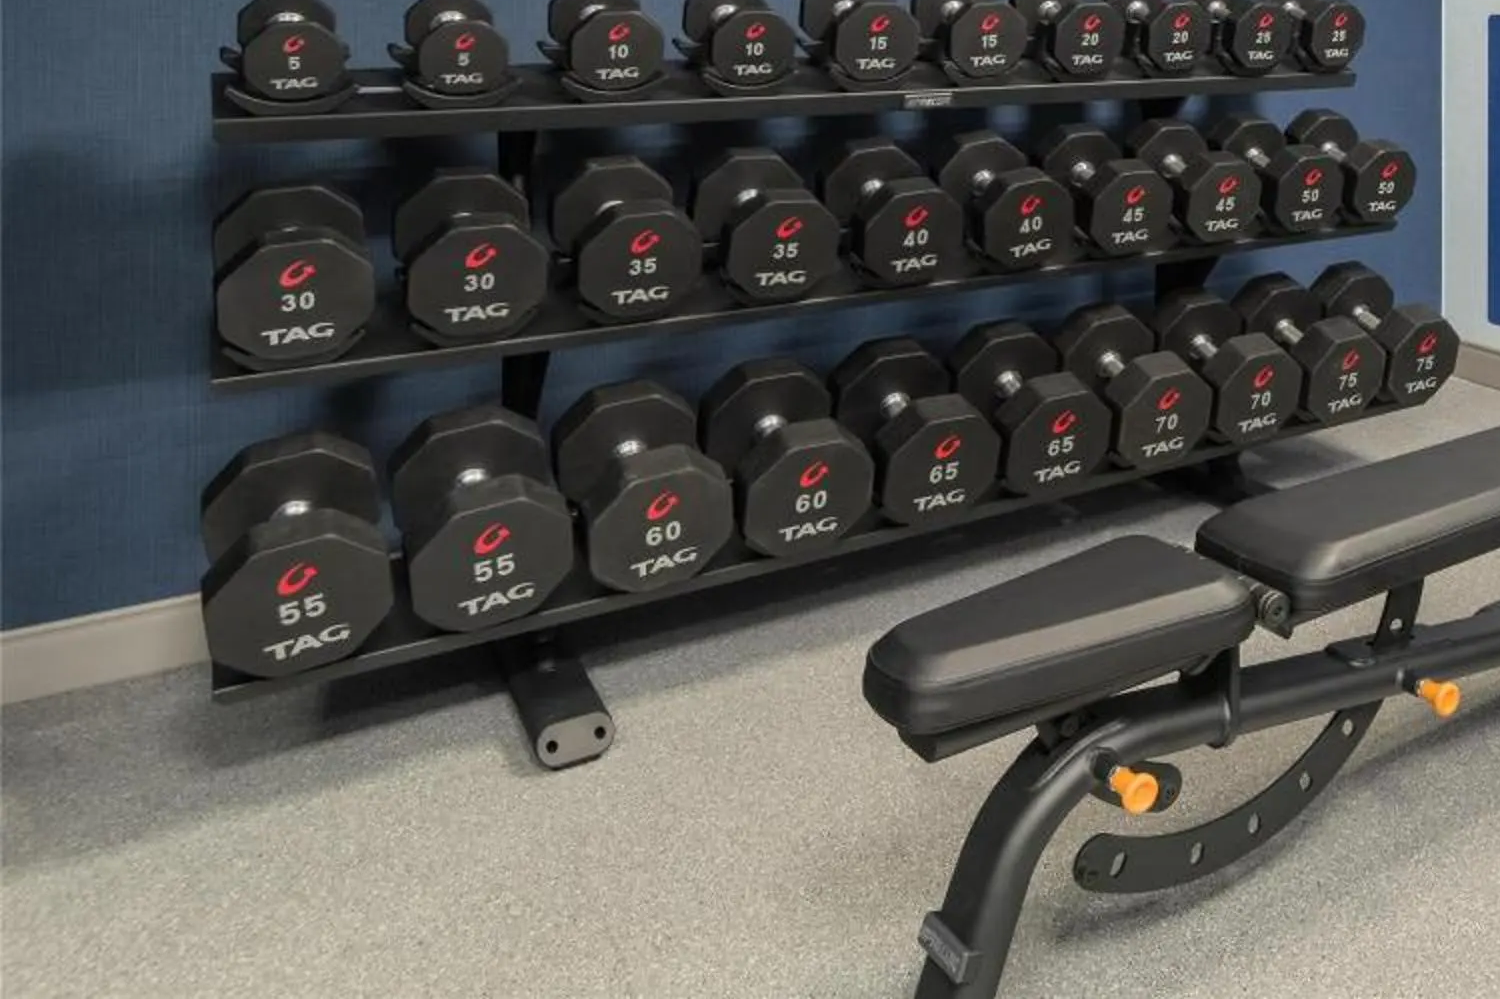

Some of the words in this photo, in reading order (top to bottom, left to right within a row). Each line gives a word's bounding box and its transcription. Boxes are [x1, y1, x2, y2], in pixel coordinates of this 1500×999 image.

[869, 36, 888, 51] 15
[981, 34, 998, 49] 15
[1081, 32, 1099, 46] 20
[1171, 30, 1189, 44] 20
[608, 44, 629, 60] 10
[745, 42, 765, 56] 10
[1163, 50, 1193, 63] TAG
[1247, 50, 1274, 61] TAG
[1324, 48, 1349, 58] TAG
[288, 56, 301, 71] 5
[457, 52, 470, 67] 5
[855, 57, 896, 70] TAG
[969, 54, 1006, 68] TAG
[1071, 54, 1104, 66] TAG
[595, 66, 640, 80] TAG
[733, 62, 773, 76] TAG
[270, 76, 319, 90] TAG
[441, 72, 483, 85] TAG
[1301, 188, 1320, 204] 50
[1377, 181, 1395, 195] 50
[1215, 196, 1236, 212] 45
[1368, 200, 1396, 212] TAG
[1122, 207, 1145, 223] 45
[1291, 208, 1323, 222] TAG
[1019, 215, 1043, 234] 40
[1205, 218, 1239, 232] TAG
[902, 228, 929, 248] 40
[1111, 228, 1149, 245] TAG
[772, 242, 799, 260] 35
[1009, 238, 1052, 258] TAG
[628, 257, 657, 276] 35
[891, 254, 938, 273] TAG
[463, 272, 495, 292] 30
[755, 270, 806, 287] TAG
[281, 291, 316, 312] 30
[611, 286, 669, 305] TAG
[444, 302, 510, 323] TAG
[260, 322, 335, 346] TAG
[1415, 354, 1435, 372] 75
[1337, 372, 1358, 391] 75
[1404, 376, 1437, 394] TAG
[1250, 390, 1272, 410] 70
[1327, 394, 1362, 414] TAG
[1155, 413, 1179, 434] 70
[1237, 412, 1277, 433] TAG
[1047, 435, 1075, 457] 65
[1141, 436, 1184, 458] TAG
[929, 461, 960, 484] 65
[1033, 460, 1081, 483] TAG
[795, 490, 828, 514] 60
[913, 488, 966, 512] TAG
[645, 520, 682, 546] 60
[778, 516, 838, 542] TAG
[473, 552, 515, 583] 55
[629, 546, 698, 578] TAG
[458, 581, 535, 616] TAG
[278, 592, 326, 626] 55
[263, 622, 351, 660] TAG
